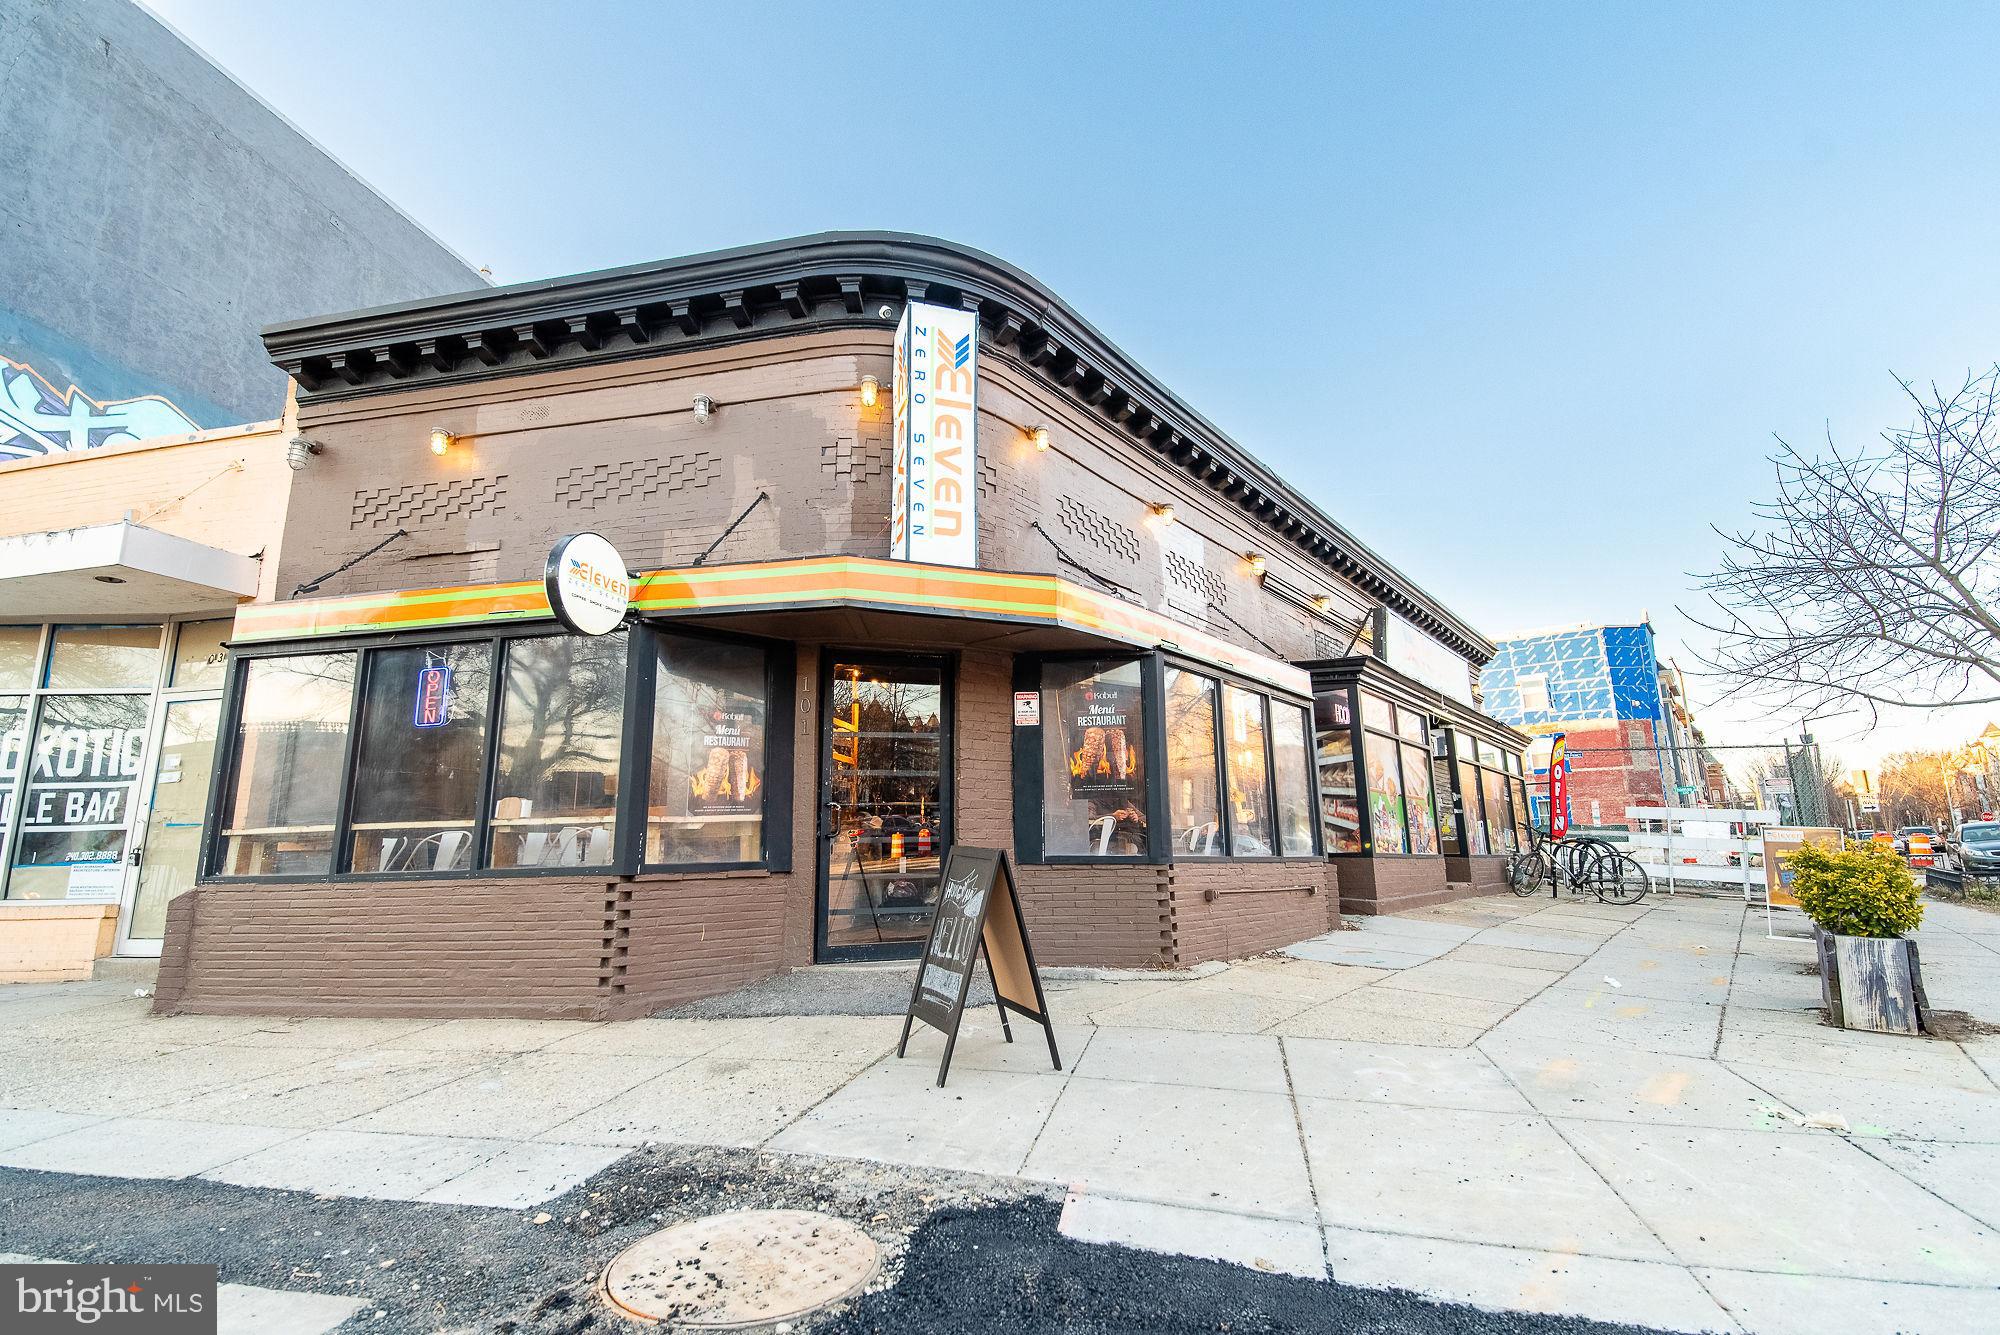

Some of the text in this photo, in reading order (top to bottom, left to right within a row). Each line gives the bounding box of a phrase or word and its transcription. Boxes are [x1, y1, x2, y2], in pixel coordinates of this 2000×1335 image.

[912, 325, 927, 537] ZERO SEVEN
[423, 670, 441, 724] OPEN
[801, 676, 812, 736] 101
[1077, 715, 1127, 727] RESTAURANT
[703, 735, 751, 747] RESTAURANT
[64, 791, 121, 823] BAR
[1553, 764, 1565, 831] OPEN
